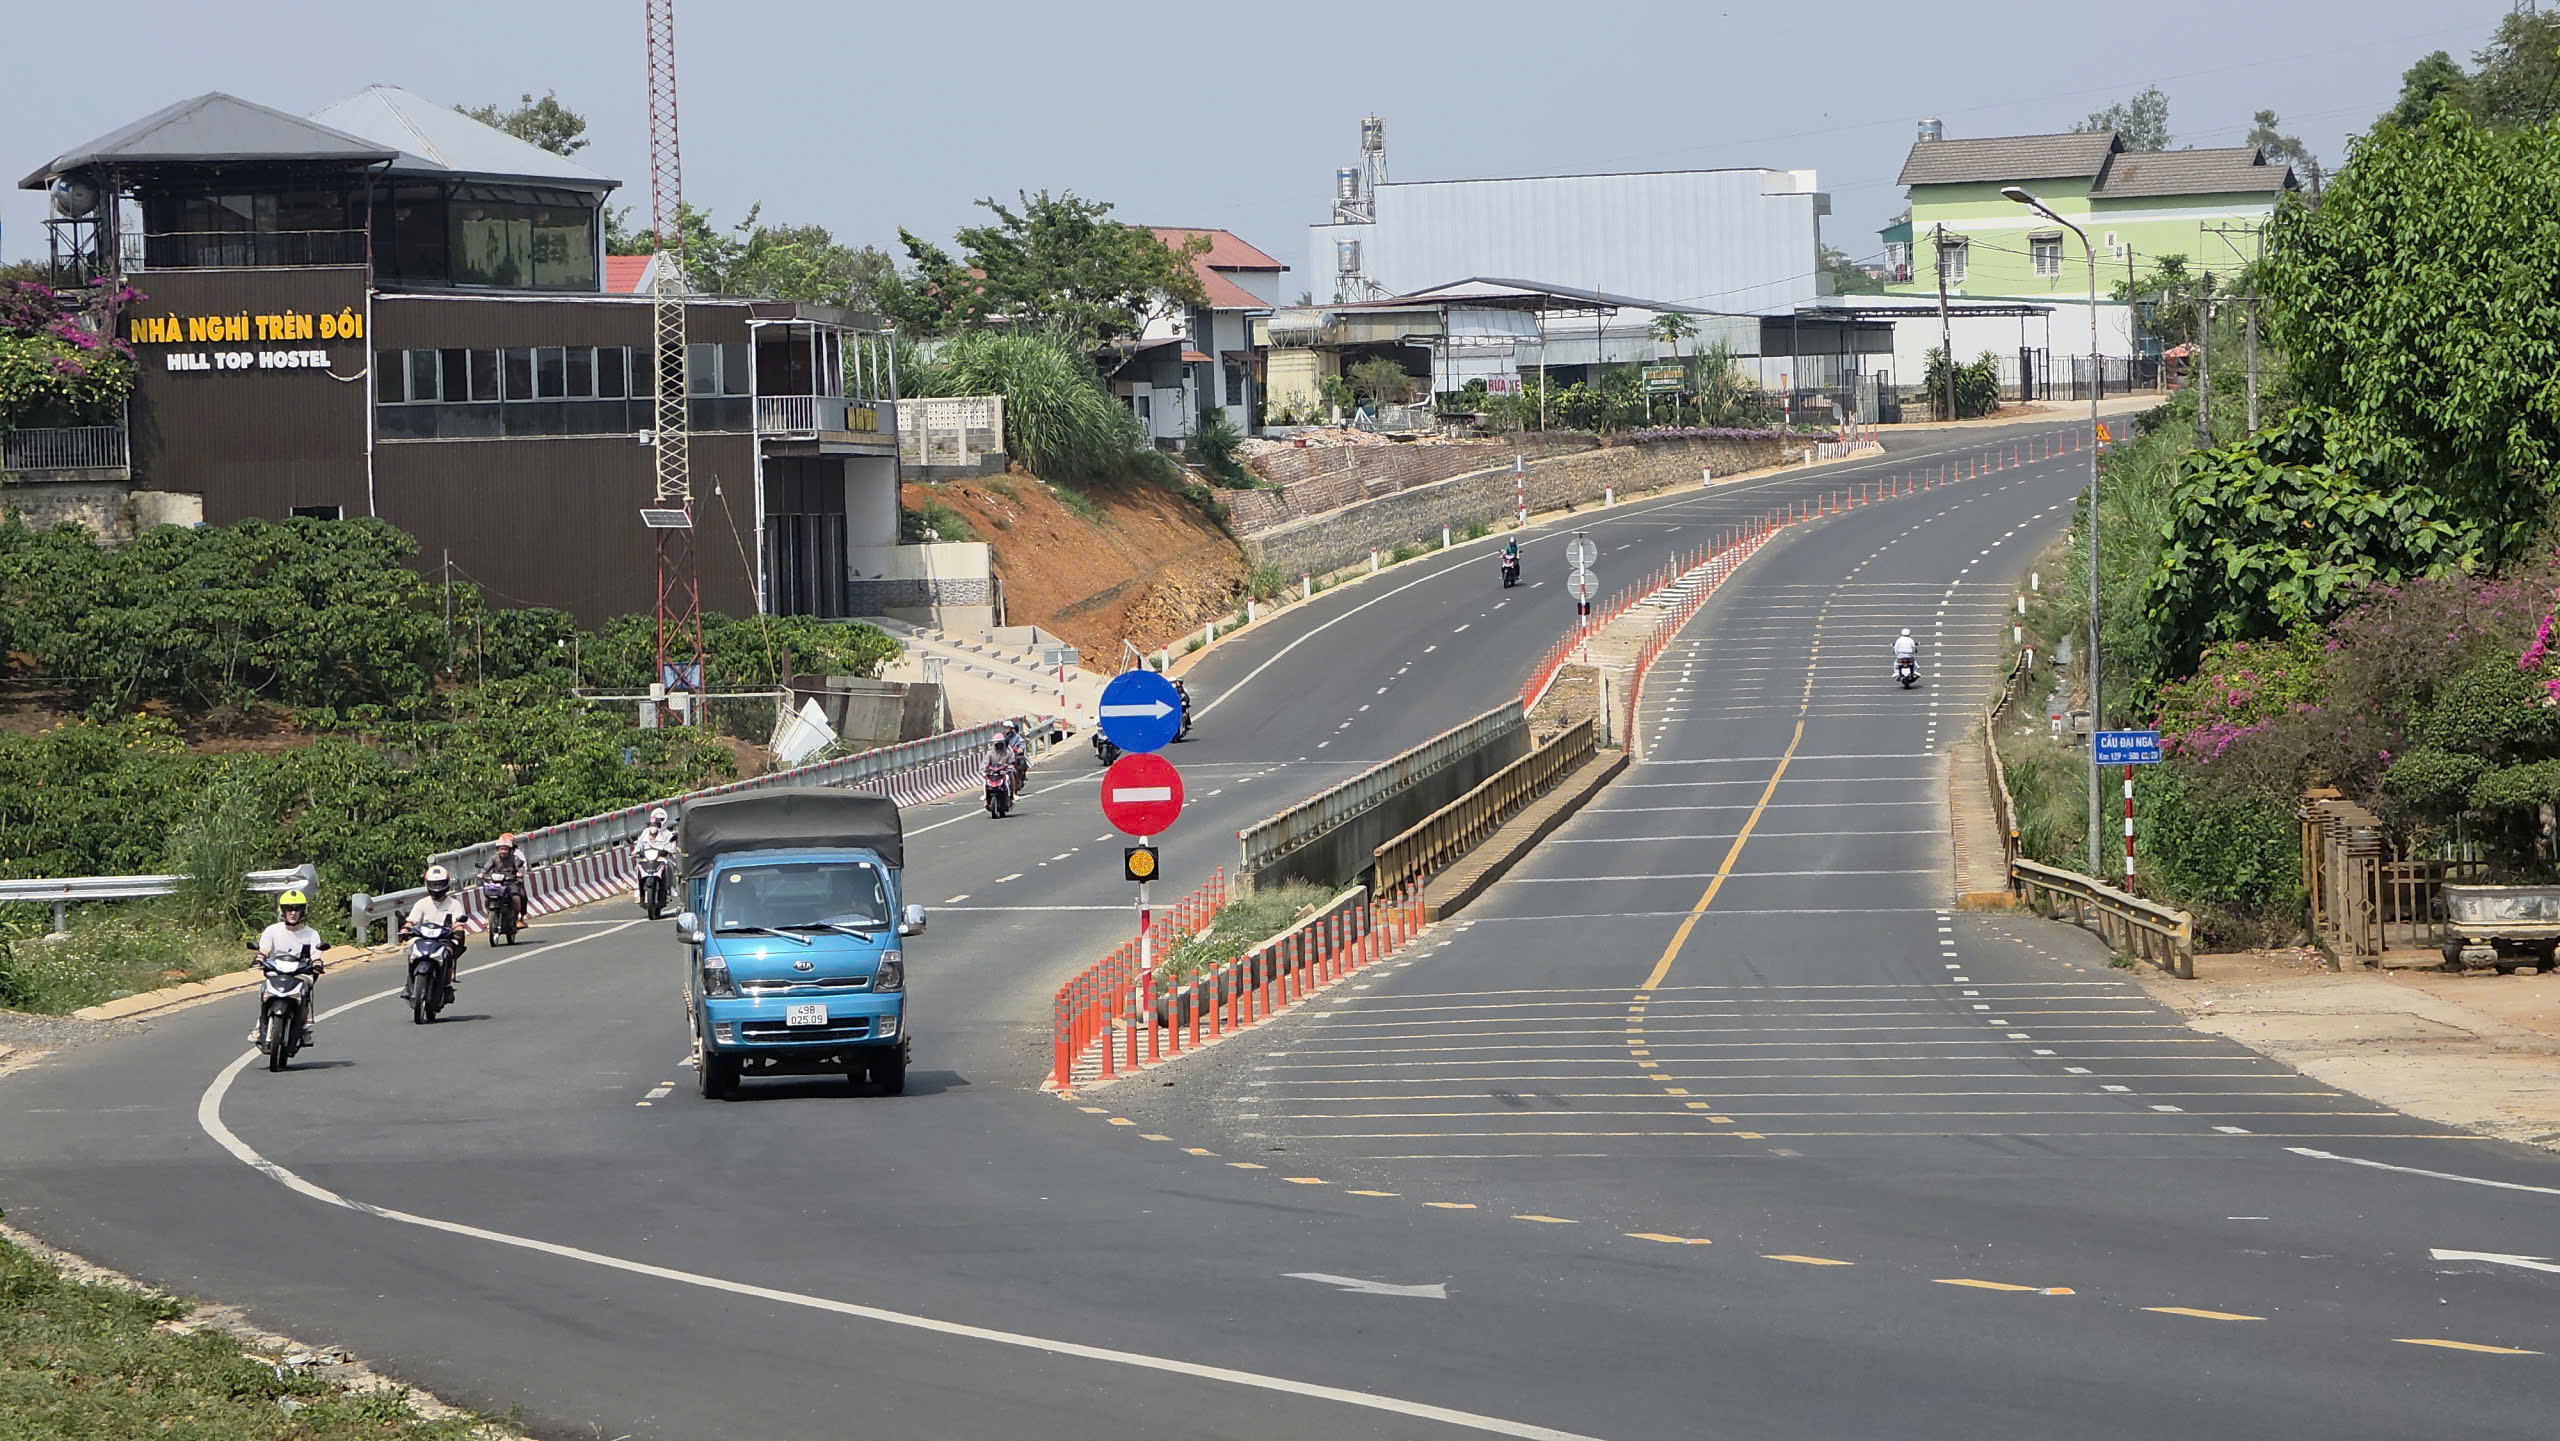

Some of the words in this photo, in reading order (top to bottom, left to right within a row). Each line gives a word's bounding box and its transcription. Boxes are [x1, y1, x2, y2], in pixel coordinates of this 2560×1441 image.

[131, 312, 183, 343] NHÀ
[189, 310, 249, 342] NGHỈ
[255, 309, 313, 340] TRÊN
[320, 306, 363, 339] ĐỒI
[167, 353, 211, 370] HILL
[214, 351, 254, 369] TOP
[259, 350, 331, 368] HOSTEL
[1509, 379, 1520, 392] XE
[2136, 736, 2154, 748] NGA
[796, 962, 811, 970] KIA
[798, 1005, 816, 1015] 49B
[791, 1015, 823, 1025] 025.09
